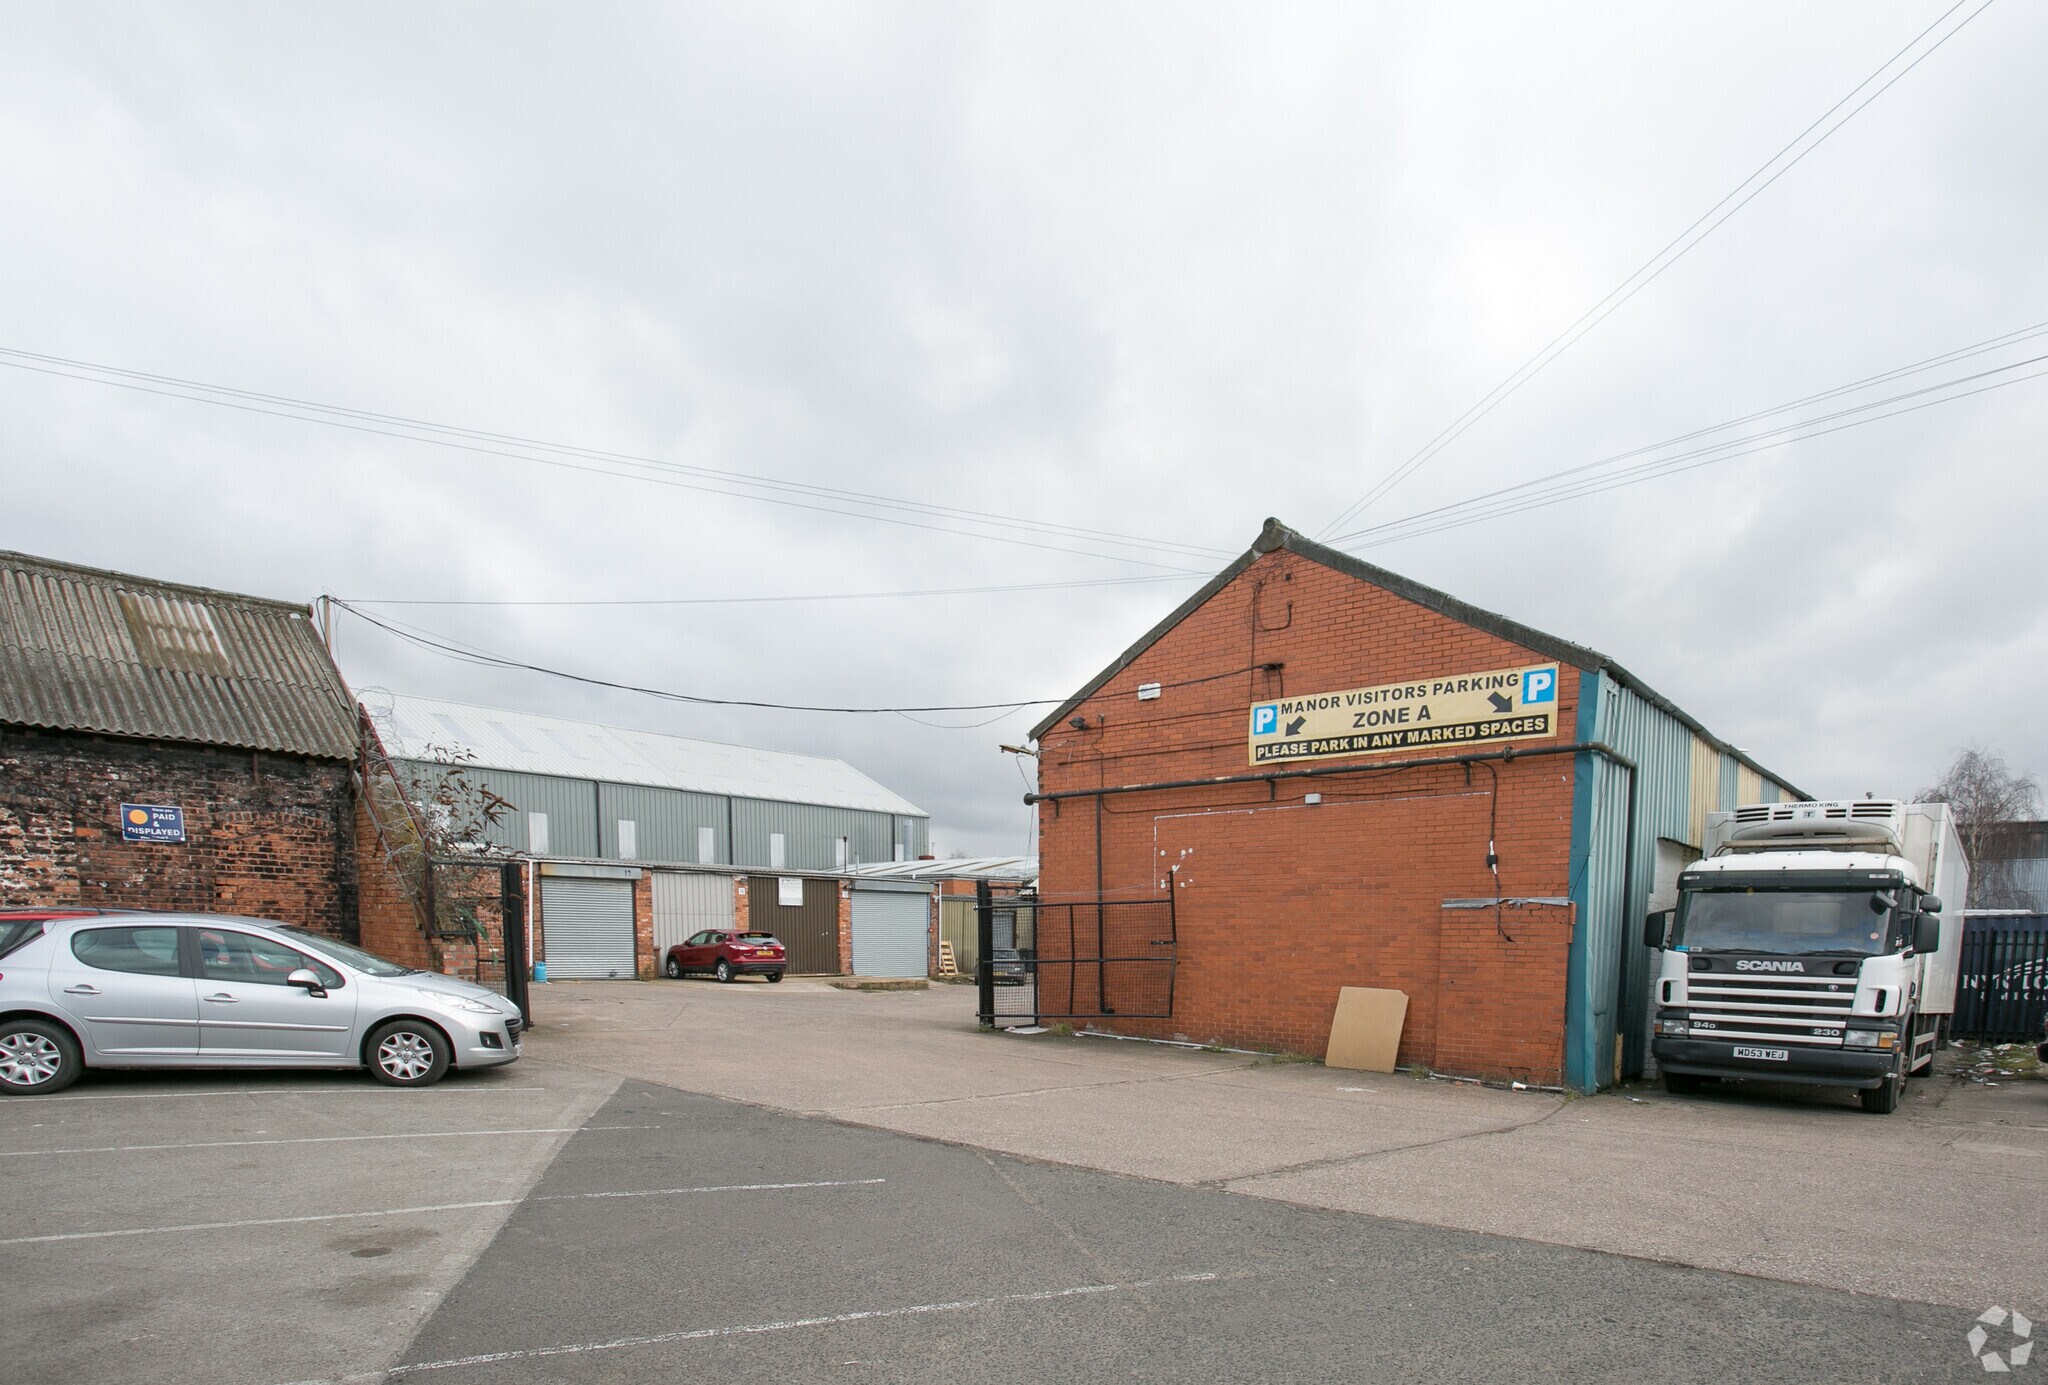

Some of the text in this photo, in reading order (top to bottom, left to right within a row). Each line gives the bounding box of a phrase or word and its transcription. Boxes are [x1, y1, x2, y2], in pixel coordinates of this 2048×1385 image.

[1281, 673, 1519, 715] MANOR VISITORS PARKING
[1528, 673, 1552, 702] P
[1256, 708, 1274, 733] P
[1352, 704, 1432, 728] ZONE A
[1257, 718, 1546, 759] PLEASE PARK IN ANY MARKED SPACES
[128, 827, 180, 836] DISPLAYED
[1736, 960, 1805, 972] SCANIA
[1693, 1021, 1716, 1029] 94D
[1812, 1028, 1841, 1036] 230
[1737, 1048, 1785, 1060] MD53 WEJ
